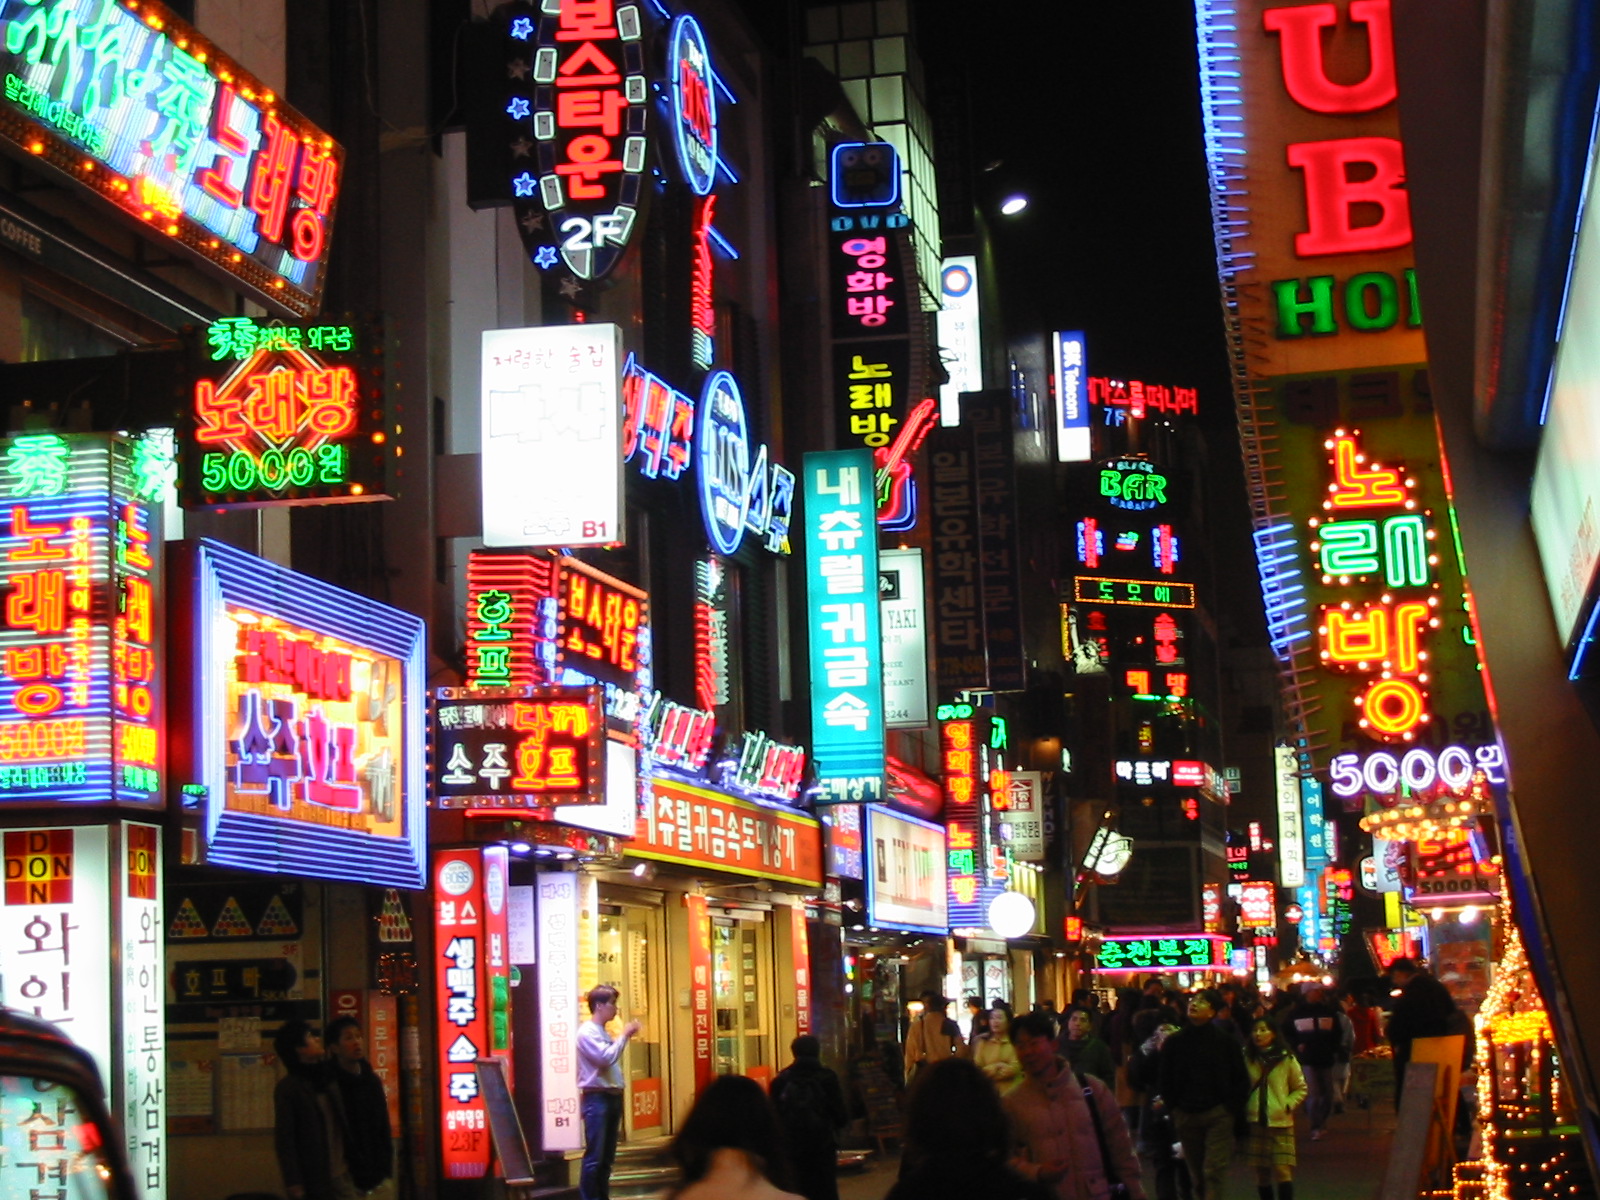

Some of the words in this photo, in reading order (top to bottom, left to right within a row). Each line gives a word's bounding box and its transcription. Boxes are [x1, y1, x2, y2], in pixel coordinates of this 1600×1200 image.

[555, 0, 626, 199] 보스타운
[202, 82, 337, 262] 노래방
[1, 218, 42, 255] COFFEE
[560, 213, 626, 251] 2F
[842, 236, 895, 327] 영화방
[307, 326, 353, 351] 외국곡
[567, 345, 604, 373] 술집
[195, 367, 358, 441] 노래방
[848, 355, 898, 447] 노래방
[1064, 367, 1080, 420] Telecom
[1087, 377, 1198, 419] 가스를떠나며
[202, 444, 343, 491] 5000원
[1100, 470, 1167, 504] BAR
[582, 521, 607, 538] B1
[931, 452, 981, 651] 일본유학센타
[1076, 522, 1086, 562] BLACK
[1152, 528, 1162, 568] BLACK
[815, 466, 871, 731] 내츄럴귀금속
[1099, 582, 1170, 603] 도모에
[1324, 430, 1430, 736] 노래방
[7, 506, 71, 714] 노래방
[888, 609, 917, 628] YAKI
[474, 589, 512, 690] 호프
[0, 719, 86, 763] 5000원
[441, 743, 512, 790] 소주
[512, 737, 581, 790] 호프
[816, 777, 882, 801] 도매상가
[1330, 746, 1506, 796] 5000원
[948, 824, 976, 904] 노래방
[439, 900, 478, 926] 보스
[1099, 938, 1210, 968] 춘천본점
[444, 936, 477, 1026] 생맥주
[448, 1033, 480, 1103] 소주
[554, 1116, 571, 1128] B1
